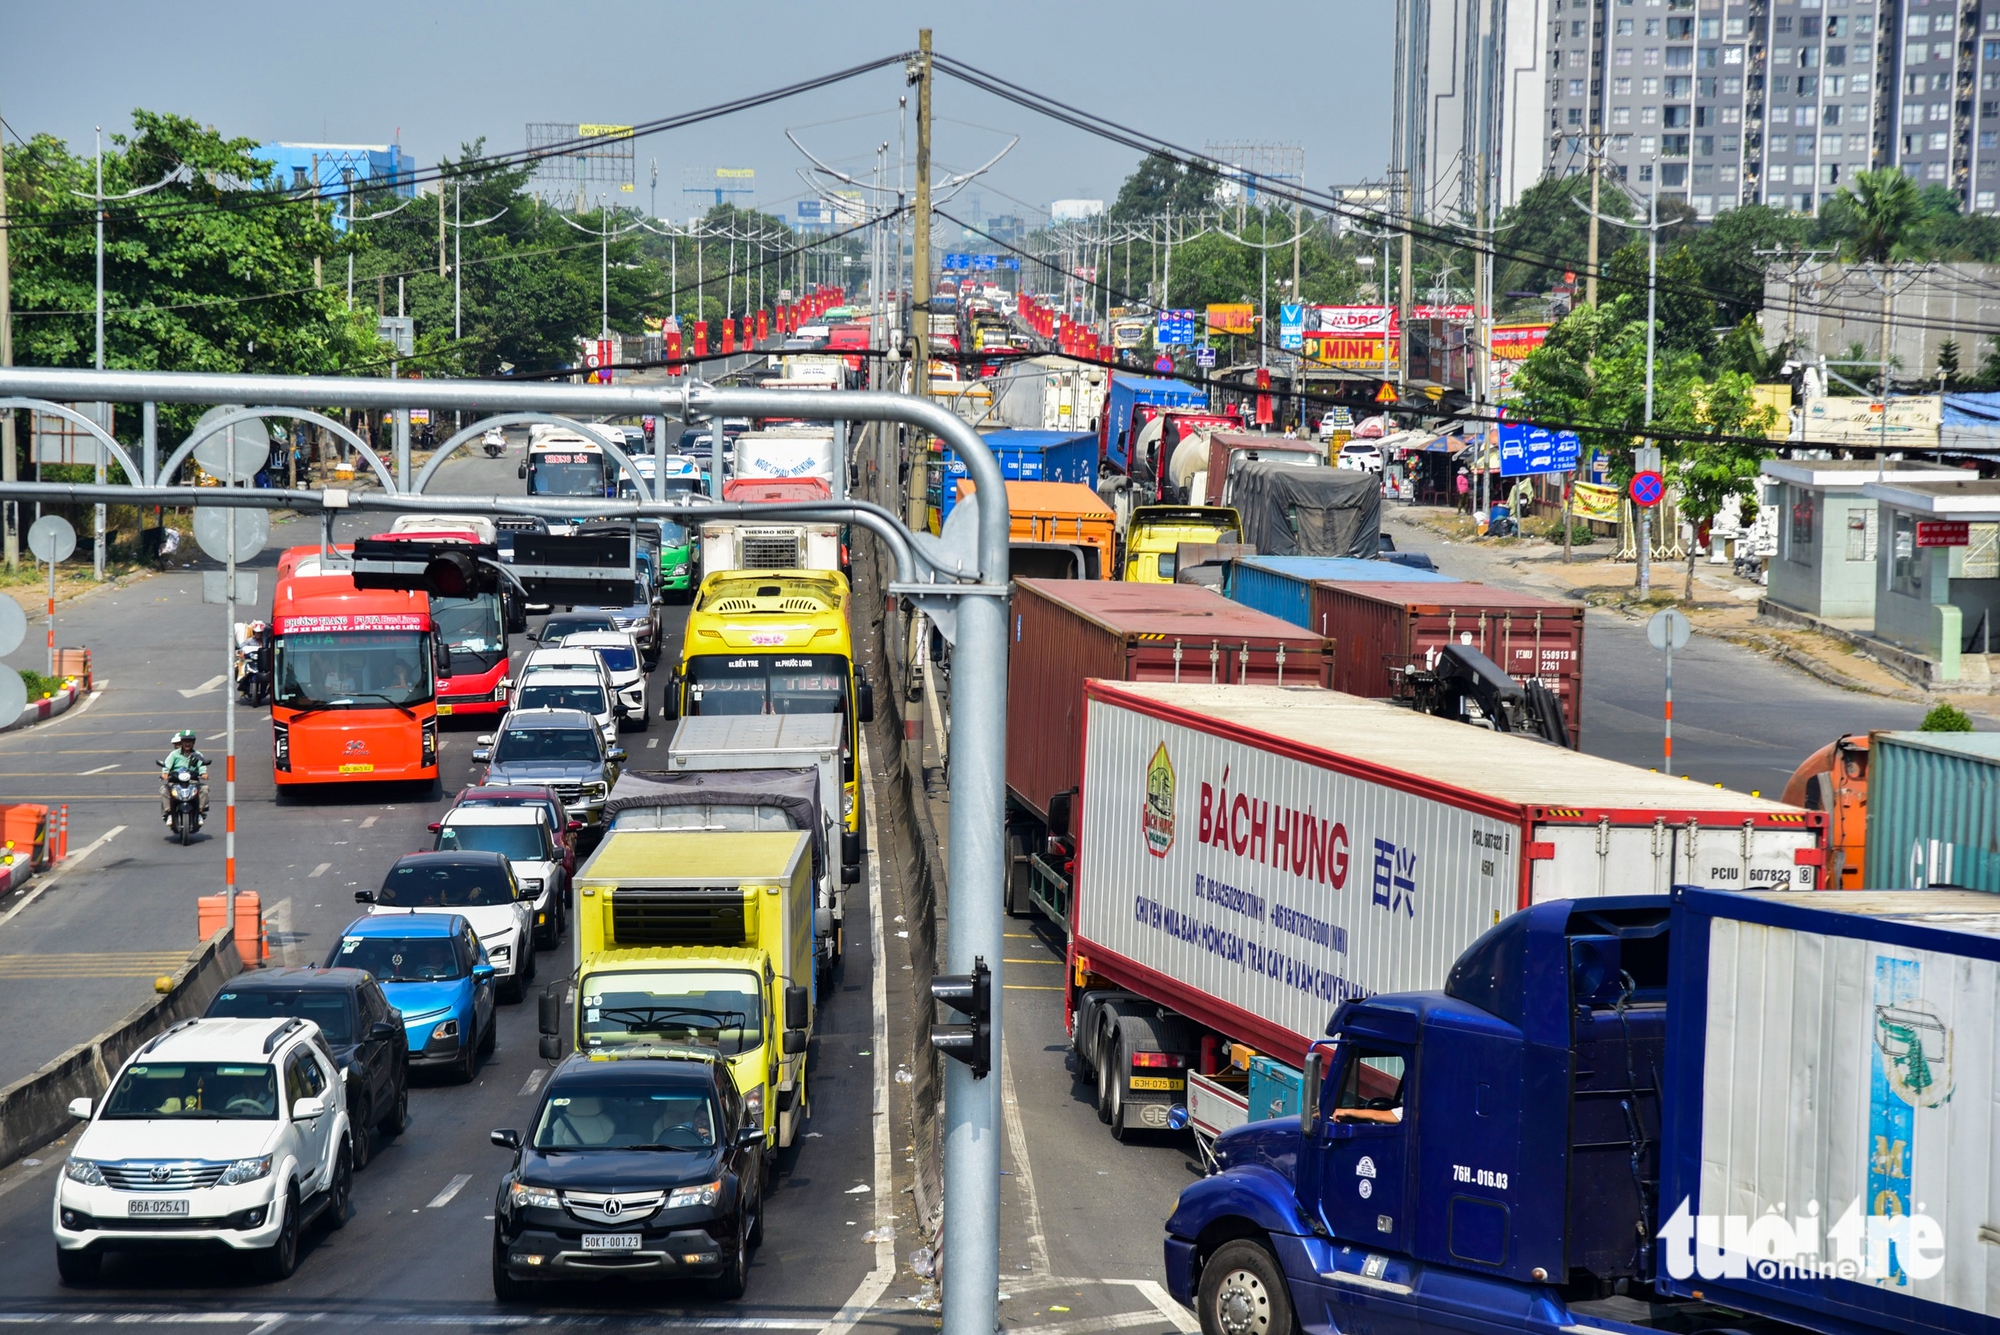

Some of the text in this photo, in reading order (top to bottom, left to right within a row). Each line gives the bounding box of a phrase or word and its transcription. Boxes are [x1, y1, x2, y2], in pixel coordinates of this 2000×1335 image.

[1347, 315, 1380, 325] DRC
[1325, 341, 1374, 359] MINH
[791, 457, 816, 476] MEKONG
[319, 616, 348, 625] TRANG
[354, 615, 380, 624] FUTA
[294, 635, 334, 645] FUTA
[1515, 650, 1533, 659] TEMU
[1542, 650, 1569, 660] 550913
[748, 660, 759, 668] TRE
[1541, 661, 1560, 670] 22G1
[1198, 763, 1350, 890] BÁCH HƯNG
[1711, 867, 1810, 882] PCIU 607823 8
[1163, 906, 1181, 939] MUA
[1286, 957, 1293, 986] &
[1351, 979, 1378, 1000] HÀ
[1134, 1079, 1180, 1089] 63H-075.01
[129, 1201, 187, 1214] 66A-025.41
[584, 1235, 640, 1248] 50KT-001.23
